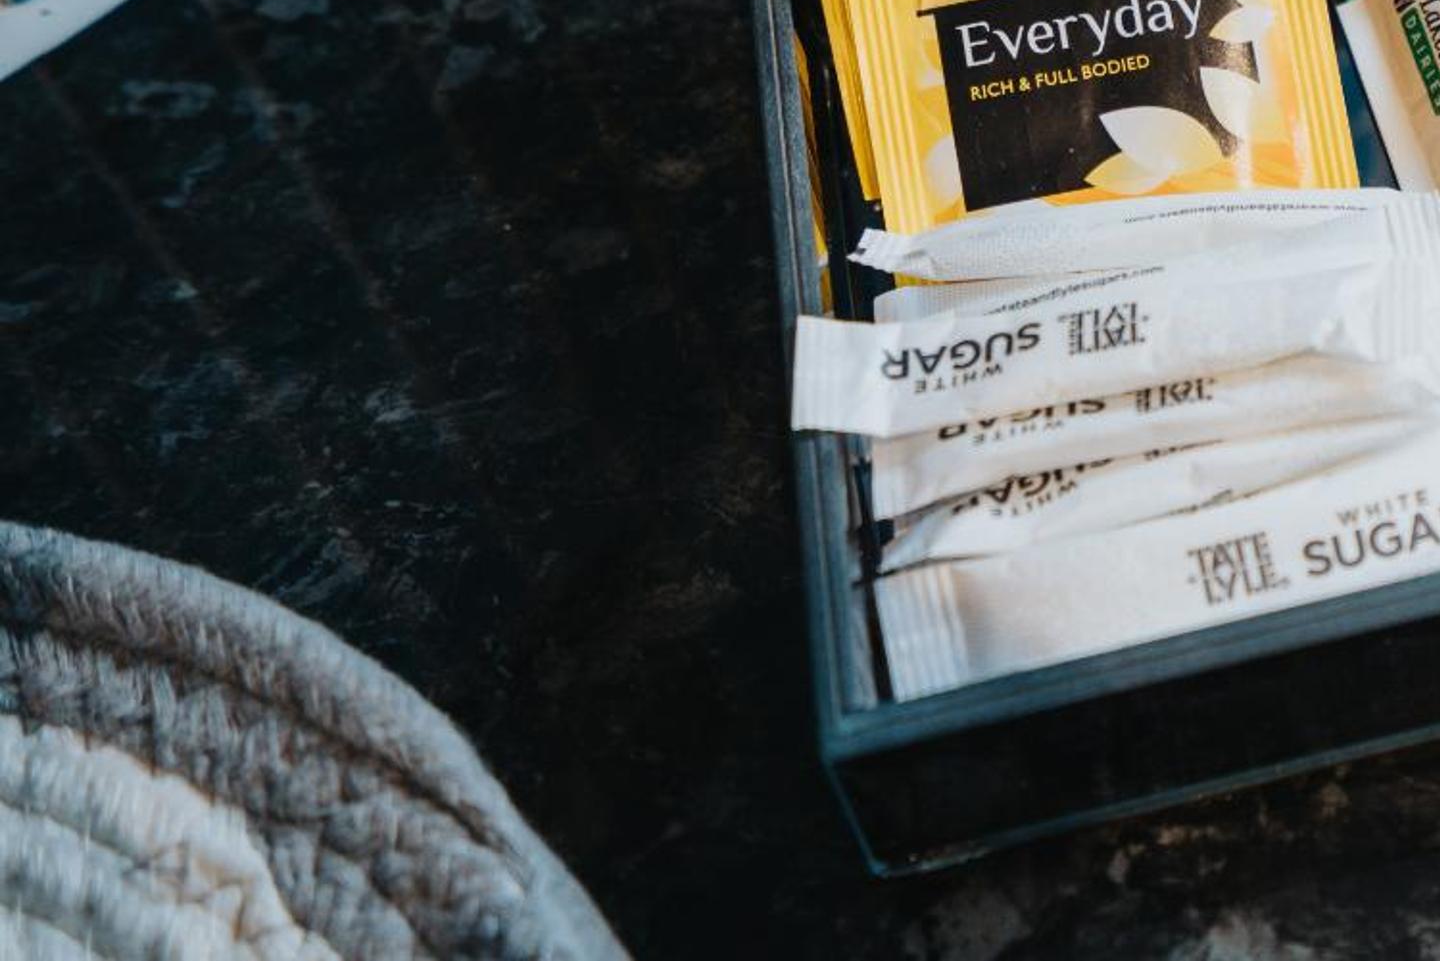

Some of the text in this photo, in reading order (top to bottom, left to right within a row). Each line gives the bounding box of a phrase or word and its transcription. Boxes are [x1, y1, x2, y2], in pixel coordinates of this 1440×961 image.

[970, 54, 1150, 101] RICH & FULL BODIED
[880, 322, 1042, 381] SUGAR
[914, 362, 1004, 395] WHITE
[990, 479, 1078, 517] WHITE
[1336, 489, 1429, 526] WHITE
[1187, 530, 1269, 571] TATE
